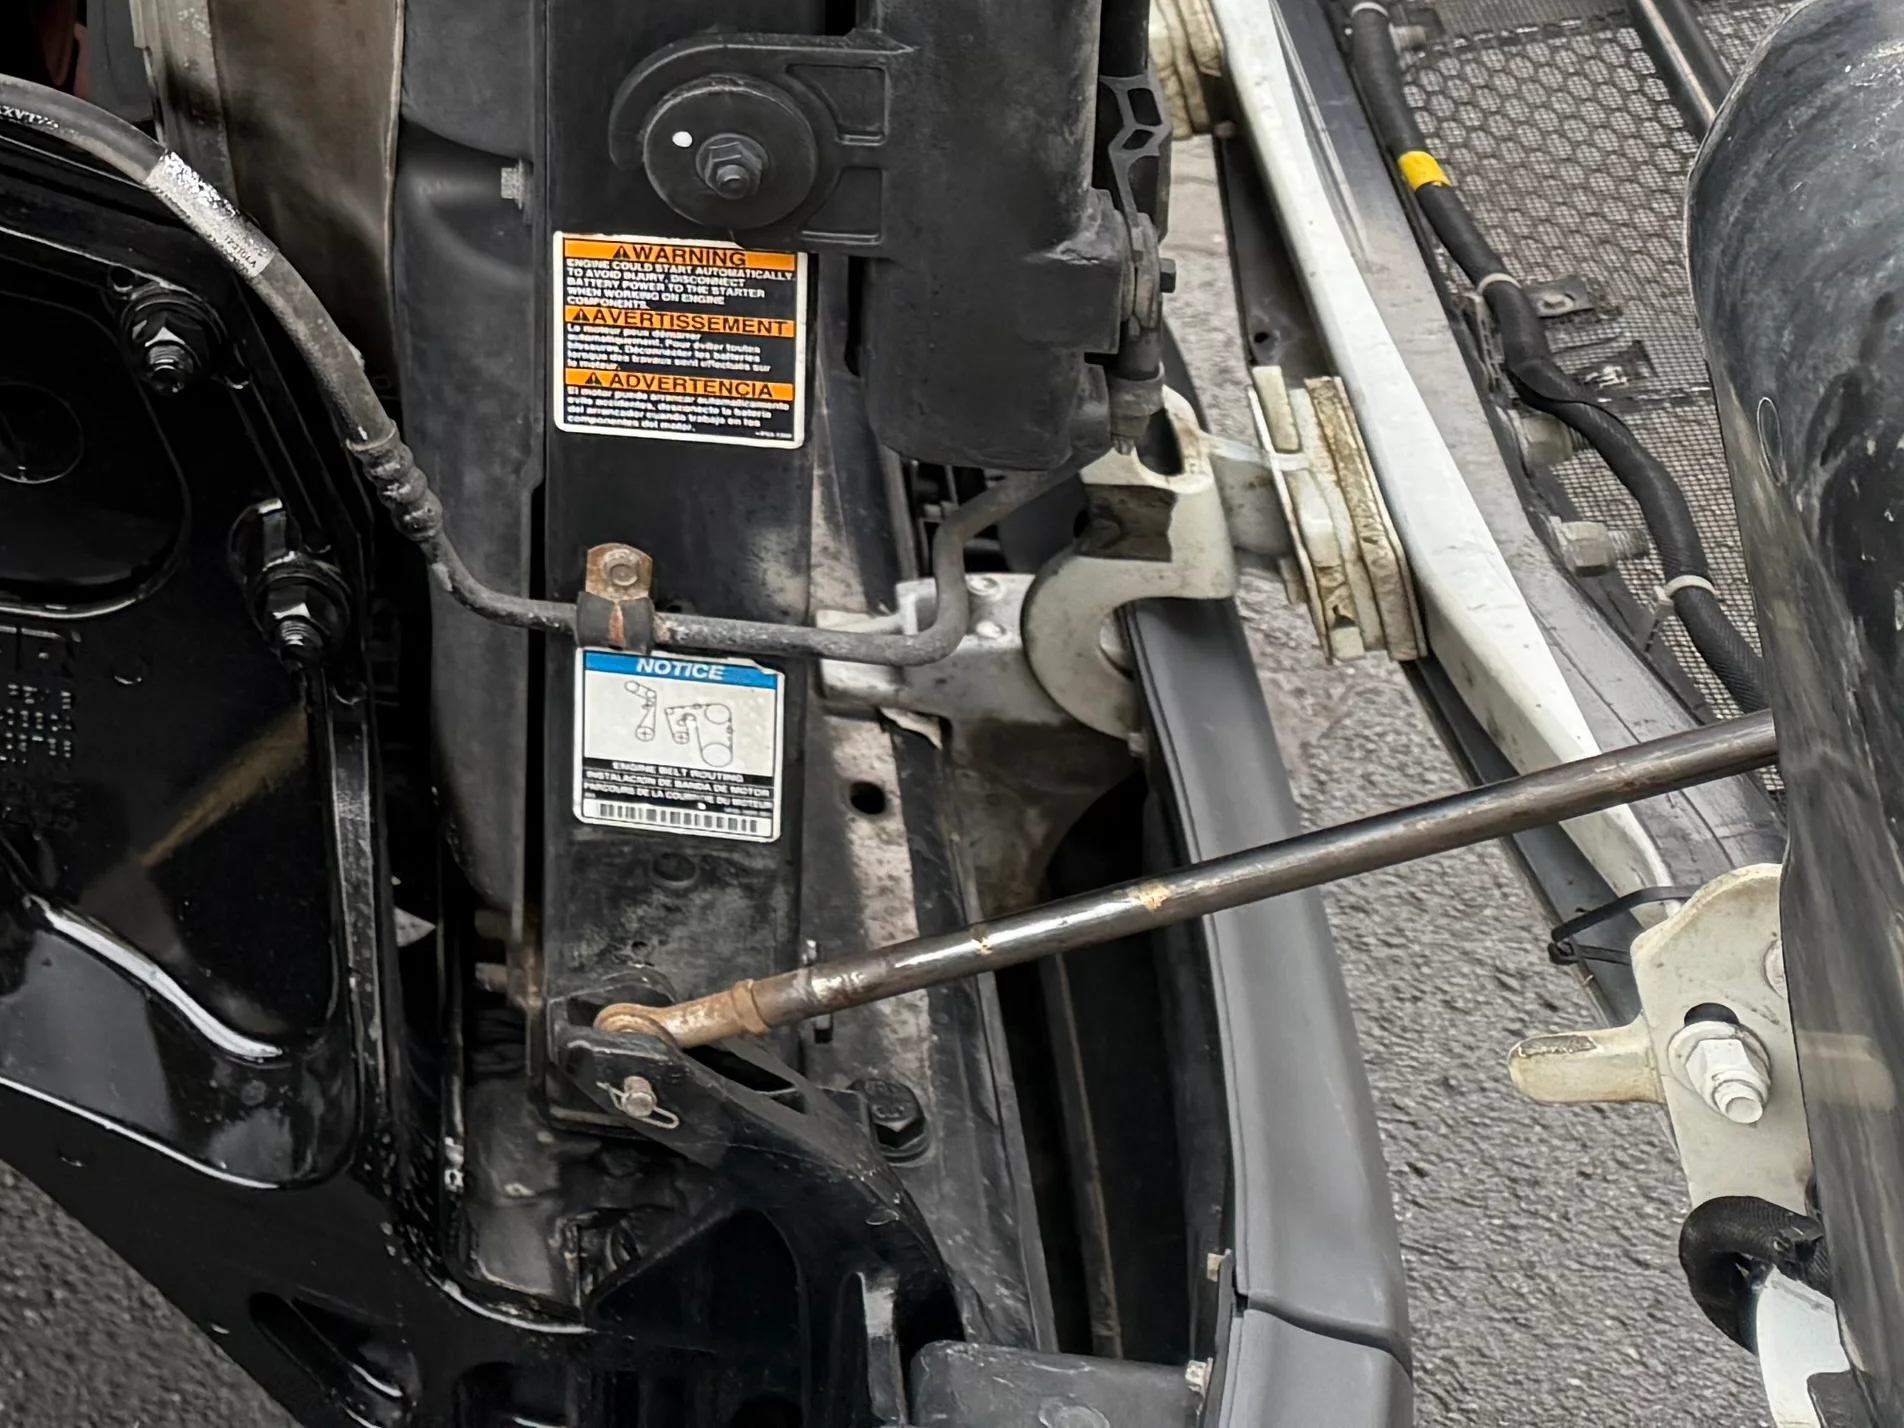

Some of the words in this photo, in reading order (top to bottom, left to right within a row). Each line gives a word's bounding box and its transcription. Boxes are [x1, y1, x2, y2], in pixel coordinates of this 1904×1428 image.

[632, 247, 746, 266] WARNING
[592, 309, 788, 336] AVERTISSEMENT
[609, 373, 773, 397] ADVERTENCIA
[636, 658, 725, 680] NOTICE
